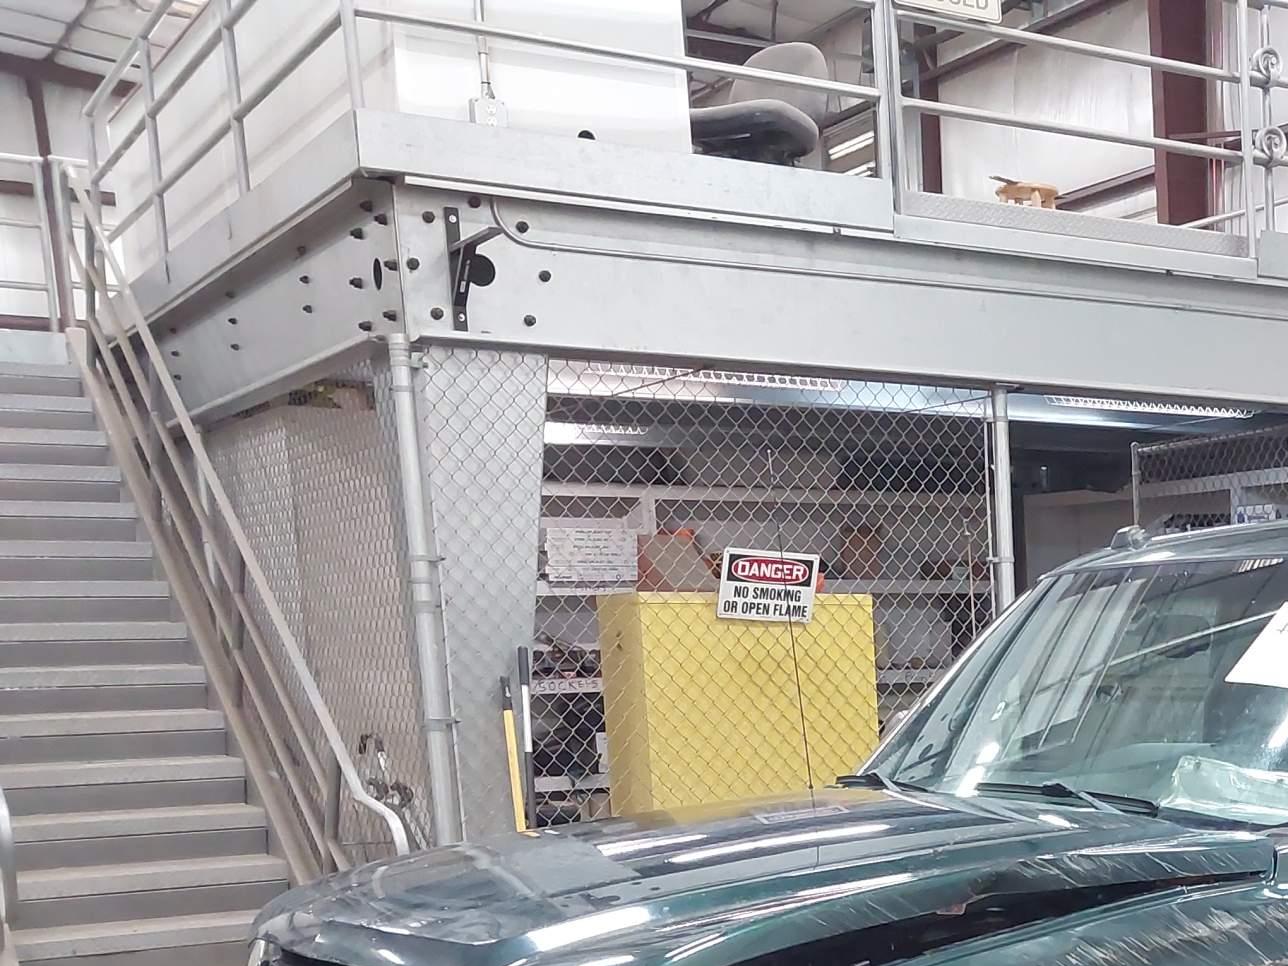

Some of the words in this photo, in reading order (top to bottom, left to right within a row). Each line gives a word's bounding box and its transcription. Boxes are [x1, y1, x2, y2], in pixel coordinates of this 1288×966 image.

[737, 561, 804, 580] DANGER
[733, 585, 749, 599] NO
[752, 587, 802, 602] SMOKING
[723, 600, 738, 613] OR
[741, 601, 770, 615] OPEN
[773, 603, 808, 618] FLAME
